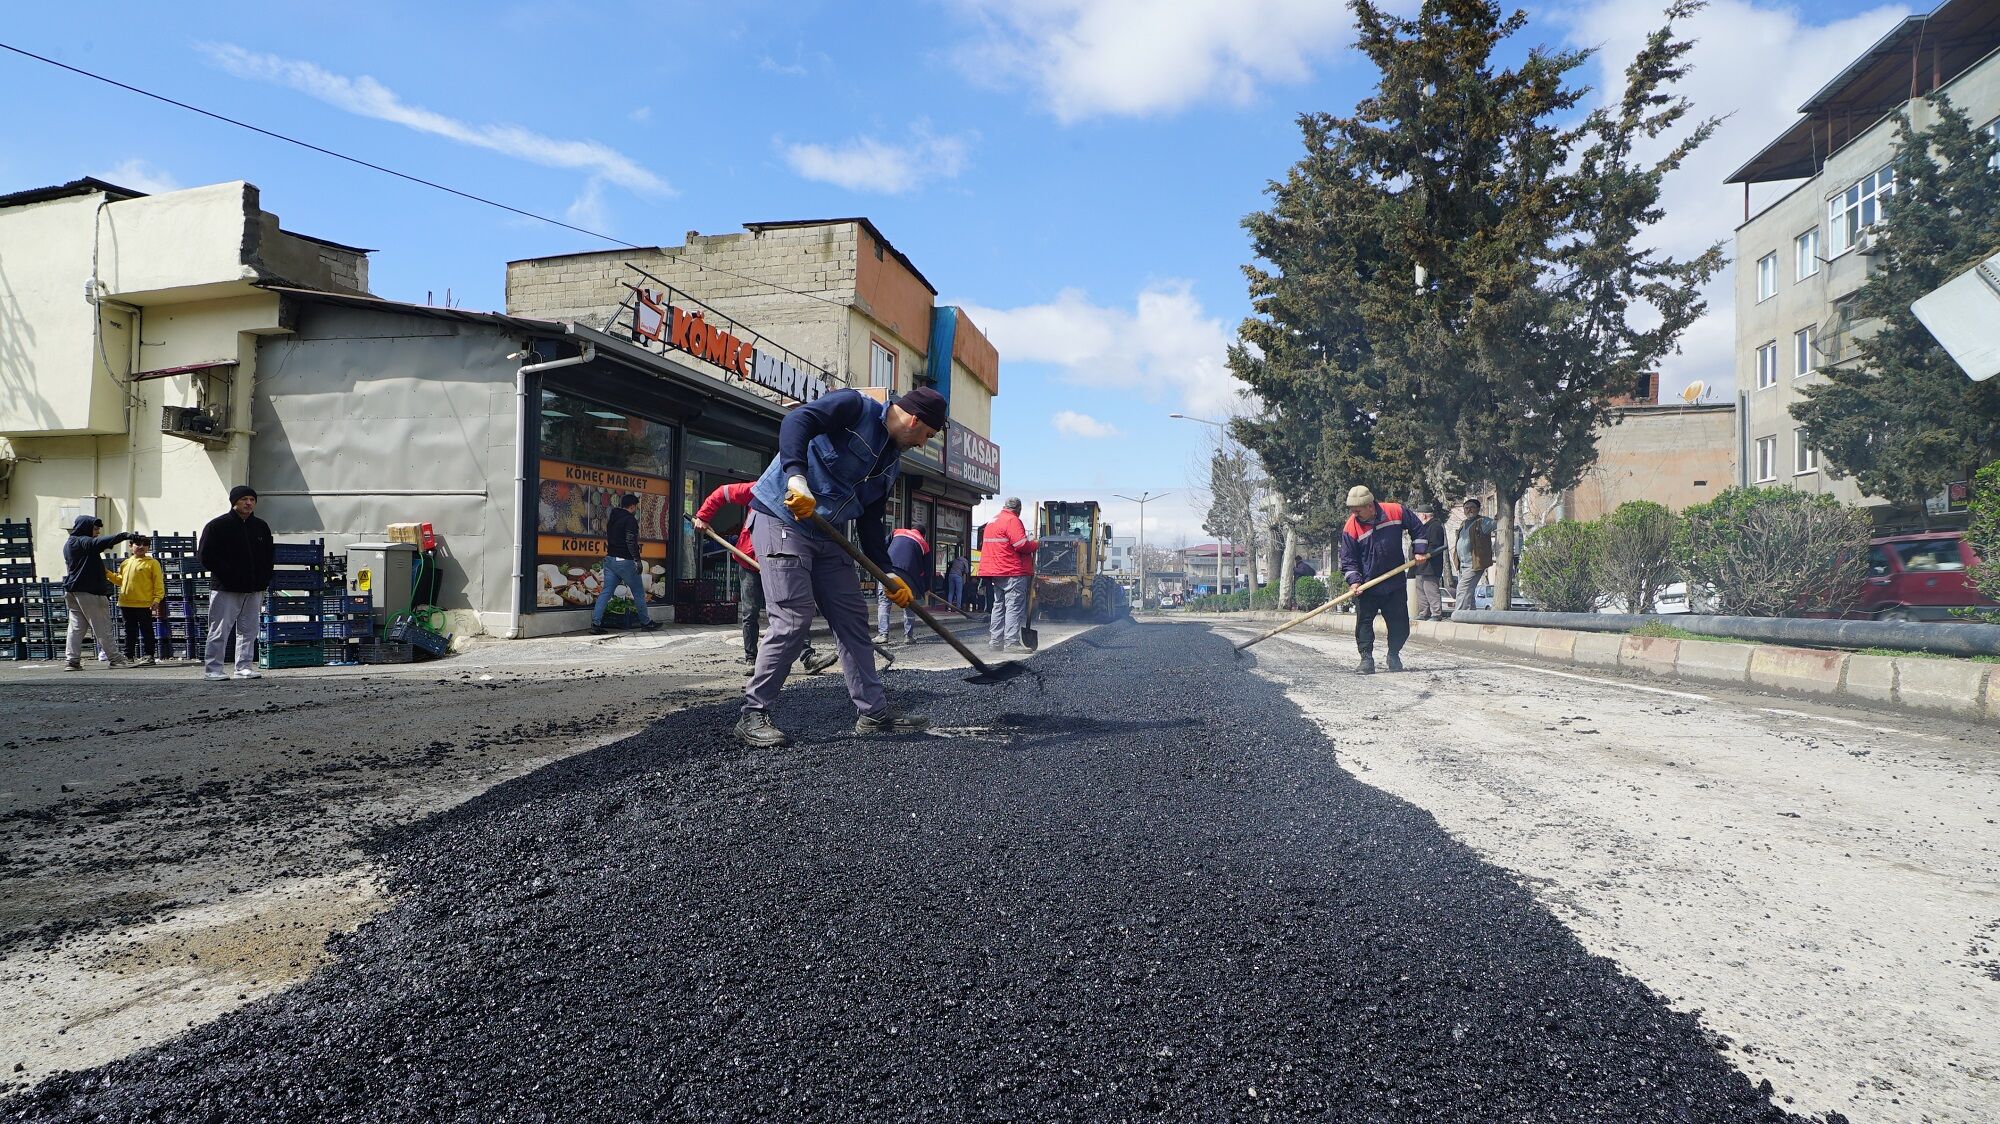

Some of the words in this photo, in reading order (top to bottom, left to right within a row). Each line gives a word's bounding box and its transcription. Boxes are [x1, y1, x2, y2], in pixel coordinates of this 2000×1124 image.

[670, 306, 753, 382] KÖMEÇ
[963, 431, 999, 468] KASAP
[566, 464, 604, 486] KÖMEÇ
[607, 473, 648, 490] MARKET
[562, 538, 600, 554] KÖMEÇ
